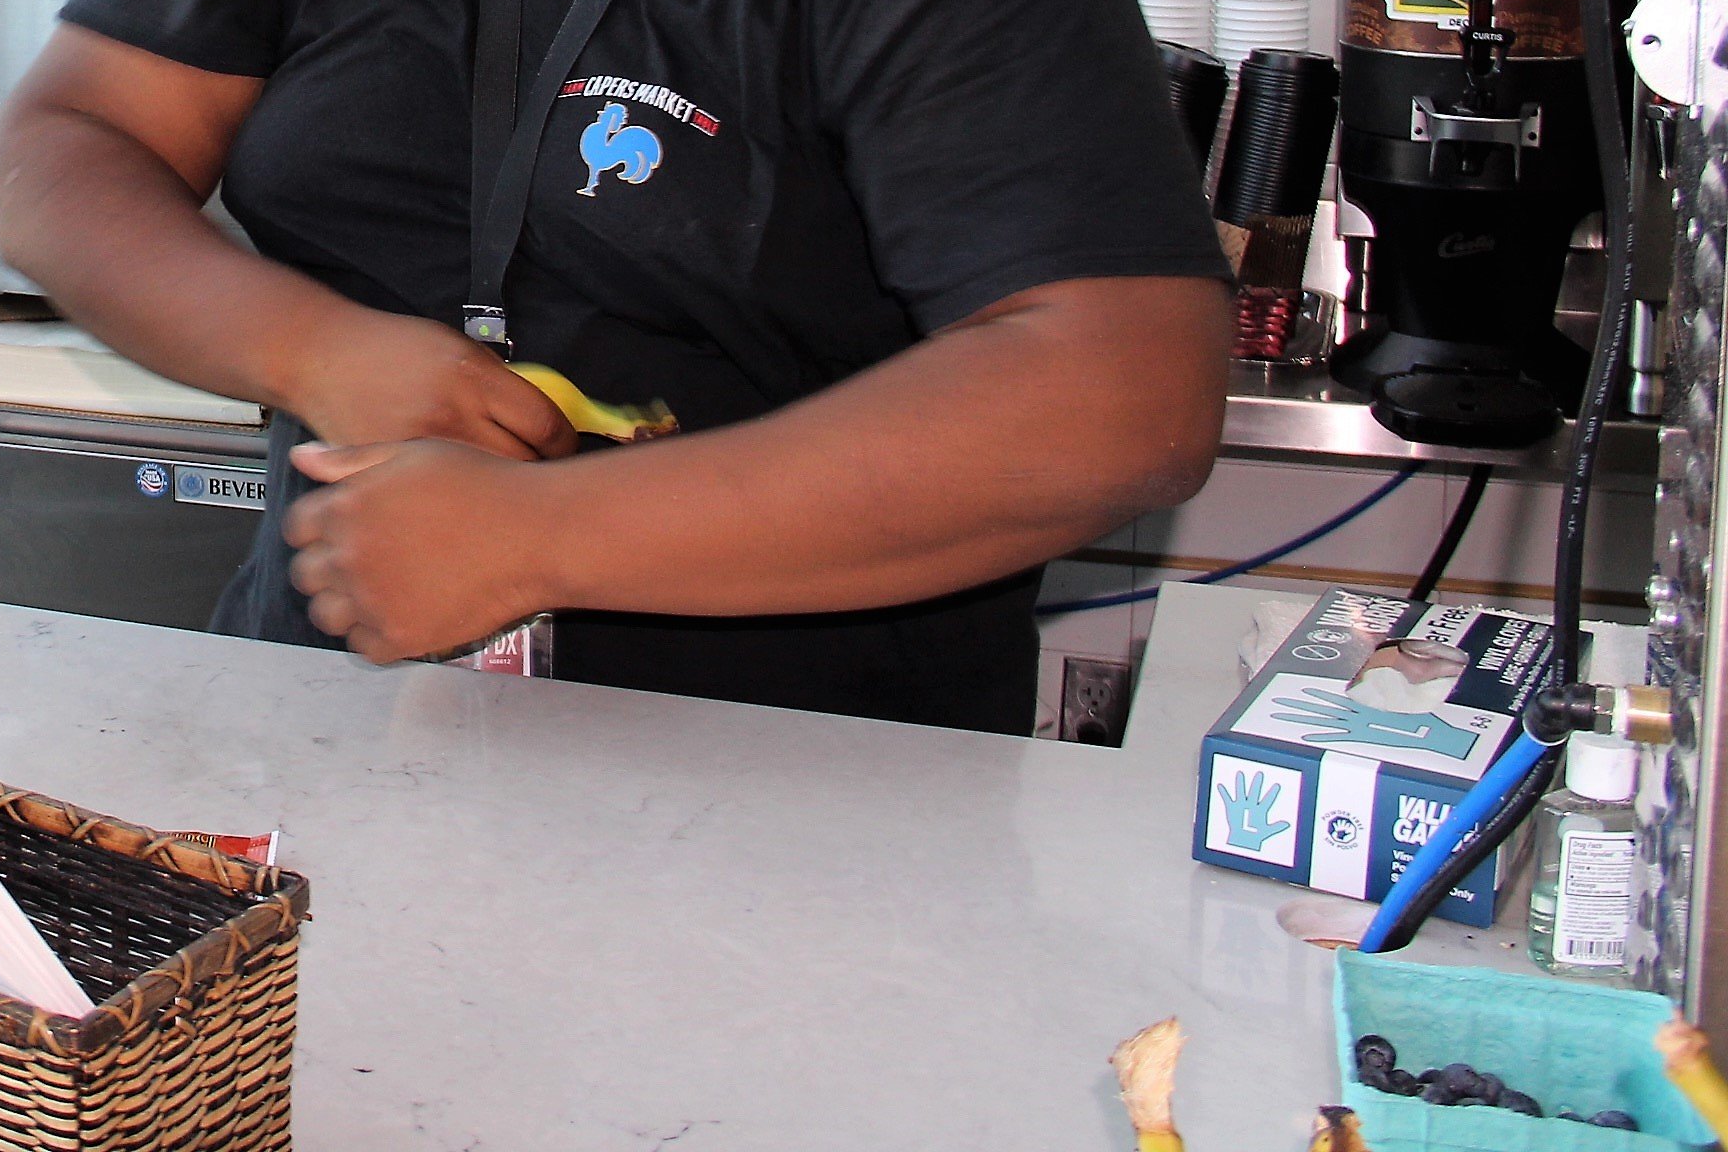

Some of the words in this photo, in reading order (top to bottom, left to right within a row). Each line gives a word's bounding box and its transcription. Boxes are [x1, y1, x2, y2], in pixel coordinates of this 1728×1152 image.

[1449, 18, 1470, 27] DEC
[1472, 30, 1503, 42] CURTIS
[583, 75, 639, 99] CAPERS
[631, 83, 697, 123] MARKET
[146, 474, 161, 482] USA
[208, 477, 267, 500] BEVER
[1352, 598, 1411, 634] GARDS
[1427, 608, 1470, 631] Free
[1475, 647, 1512, 671] VINYL
[1368, 722, 1431, 739] L
[1243, 808, 1258, 833] L
[1392, 849, 1414, 862] Vin
[1572, 841, 1587, 850] Drug
